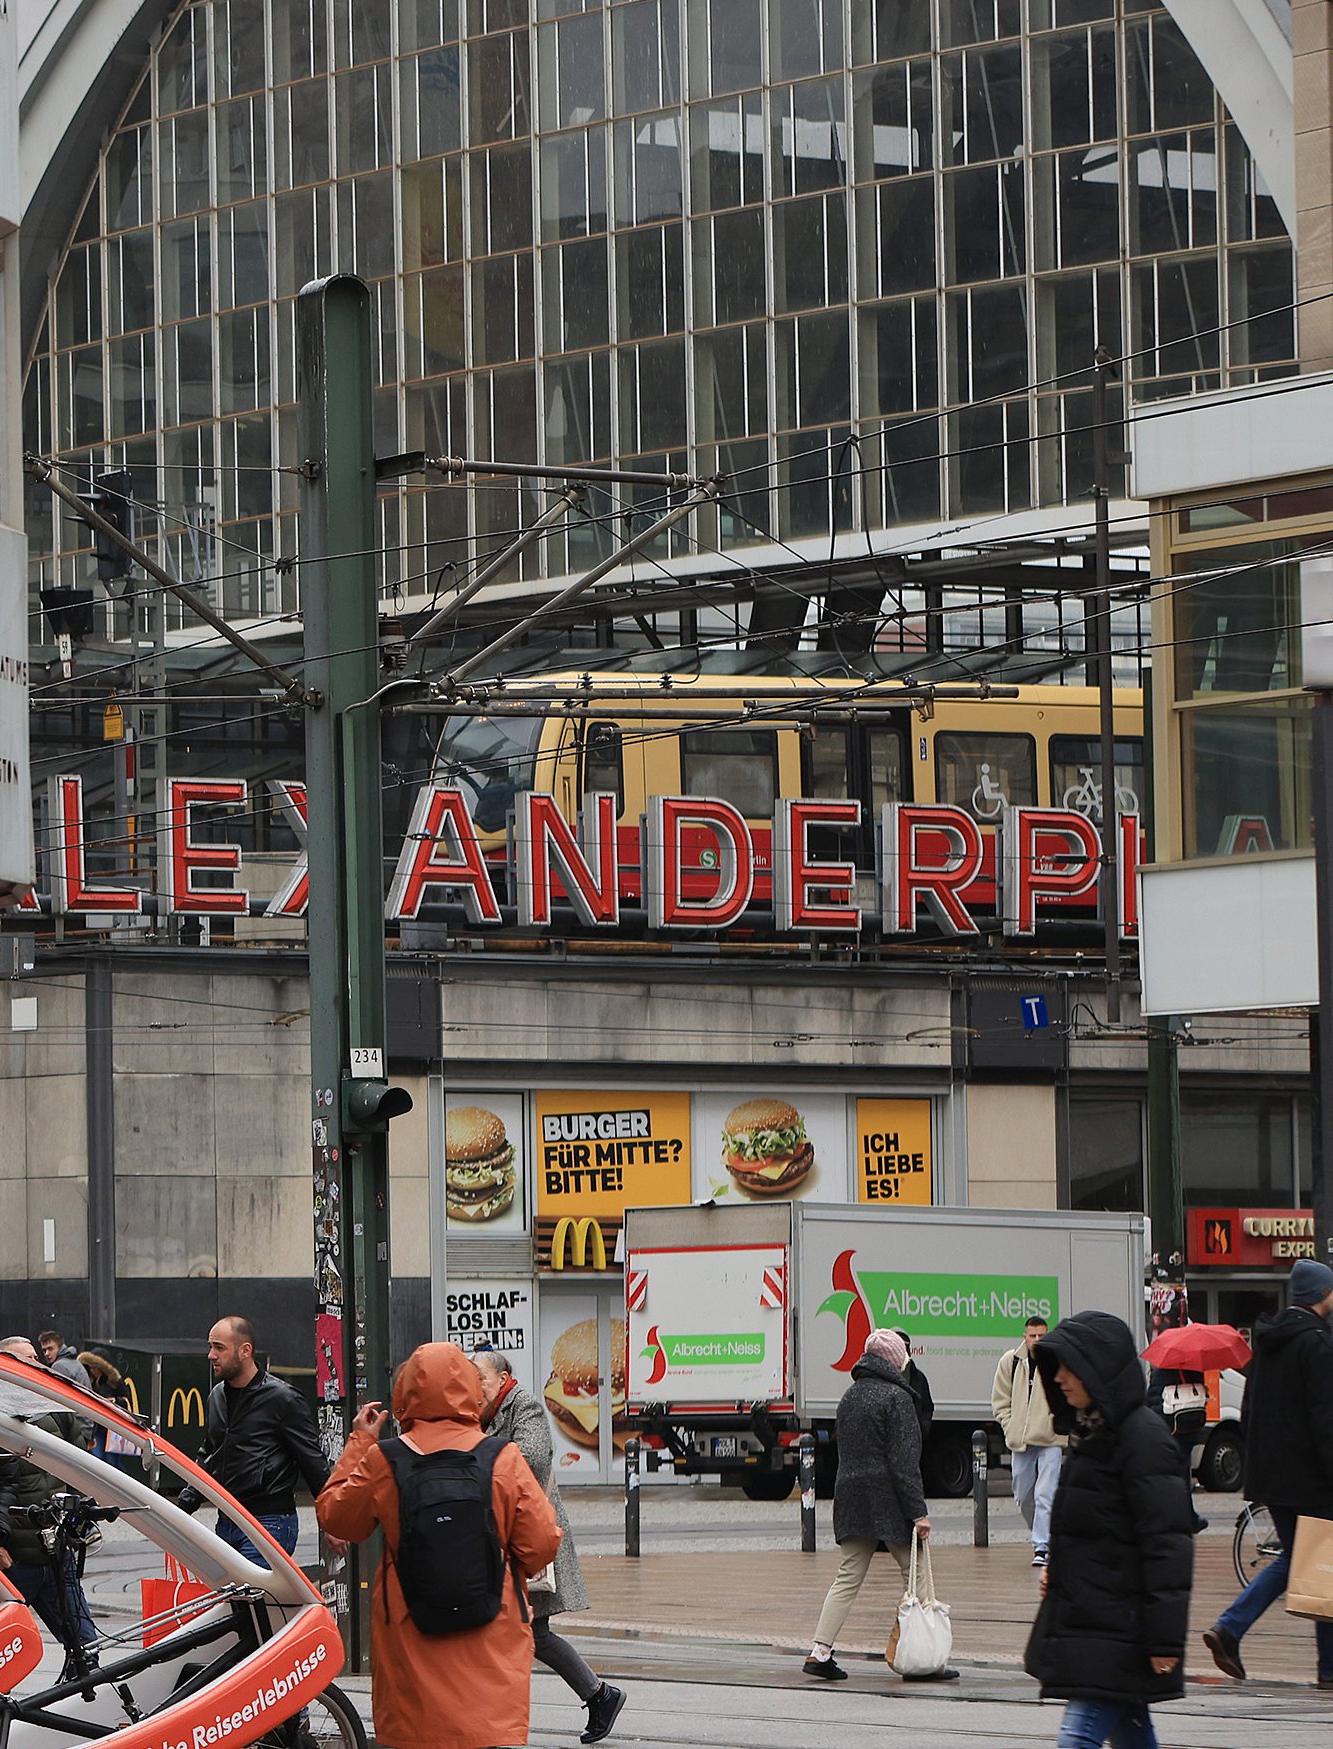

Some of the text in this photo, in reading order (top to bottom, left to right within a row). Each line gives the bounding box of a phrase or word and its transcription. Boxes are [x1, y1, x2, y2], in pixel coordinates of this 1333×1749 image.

[354, 1049, 378, 1063] 234
[543, 1111, 650, 1142] BURGER
[595, 1138, 682, 1166] MITTE?
[864, 1133, 899, 1153] ICH
[865, 1153, 924, 1175] LIEBE
[546, 1168, 623, 1194] BITTE!
[866, 1179, 900, 1199] ES!
[447, 1291, 527, 1312] SCHLAF-
[884, 1289, 1051, 1319] Albrecht+Neiss
[448, 1311, 506, 1331] LOS IN
[672, 1341, 761, 1357] Albrecht+Neiss
[192, 1642, 327, 1749] Reiseerlebnisse
